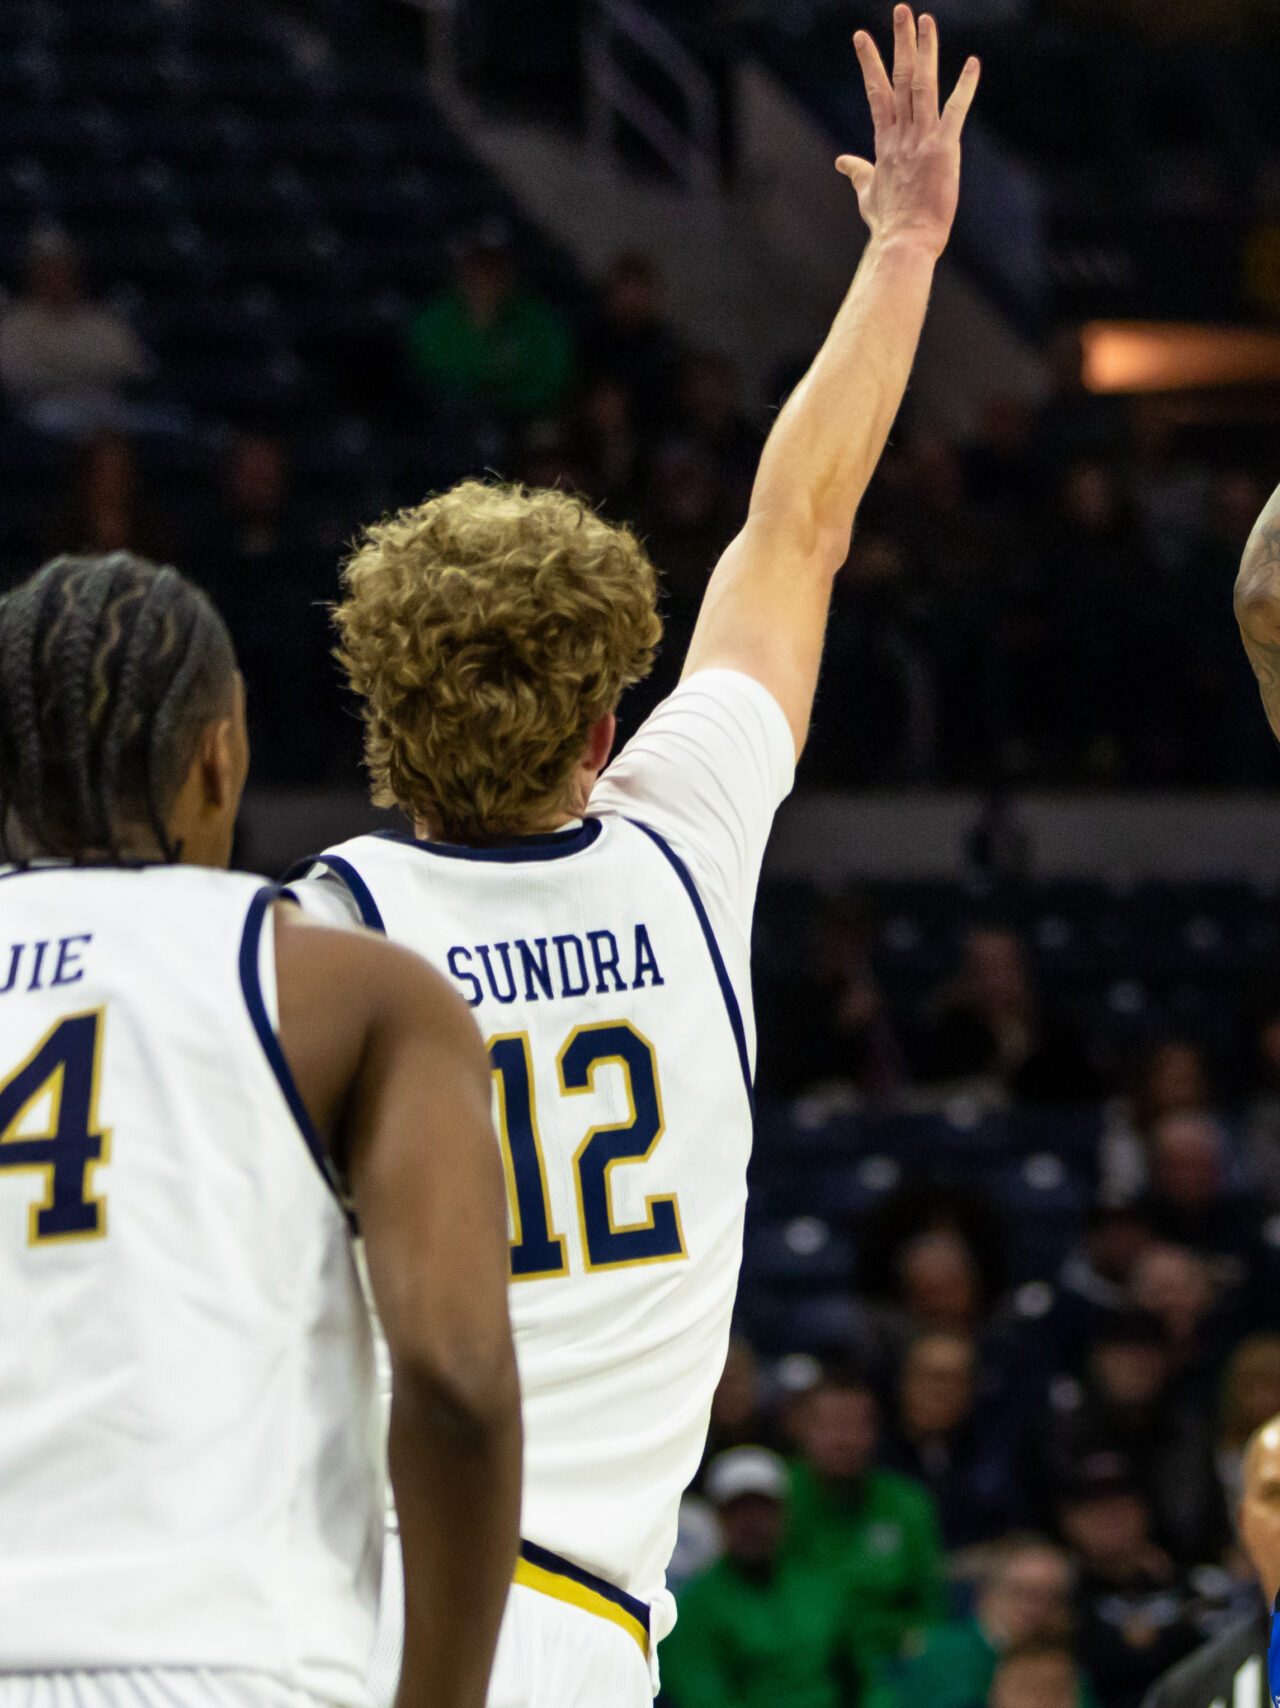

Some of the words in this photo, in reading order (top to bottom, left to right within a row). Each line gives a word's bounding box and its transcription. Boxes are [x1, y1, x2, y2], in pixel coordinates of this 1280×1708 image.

[447, 923, 665, 1008] SUNDRA
[0, 1004, 113, 1247] 4
[484, 1018, 690, 1284] 12
